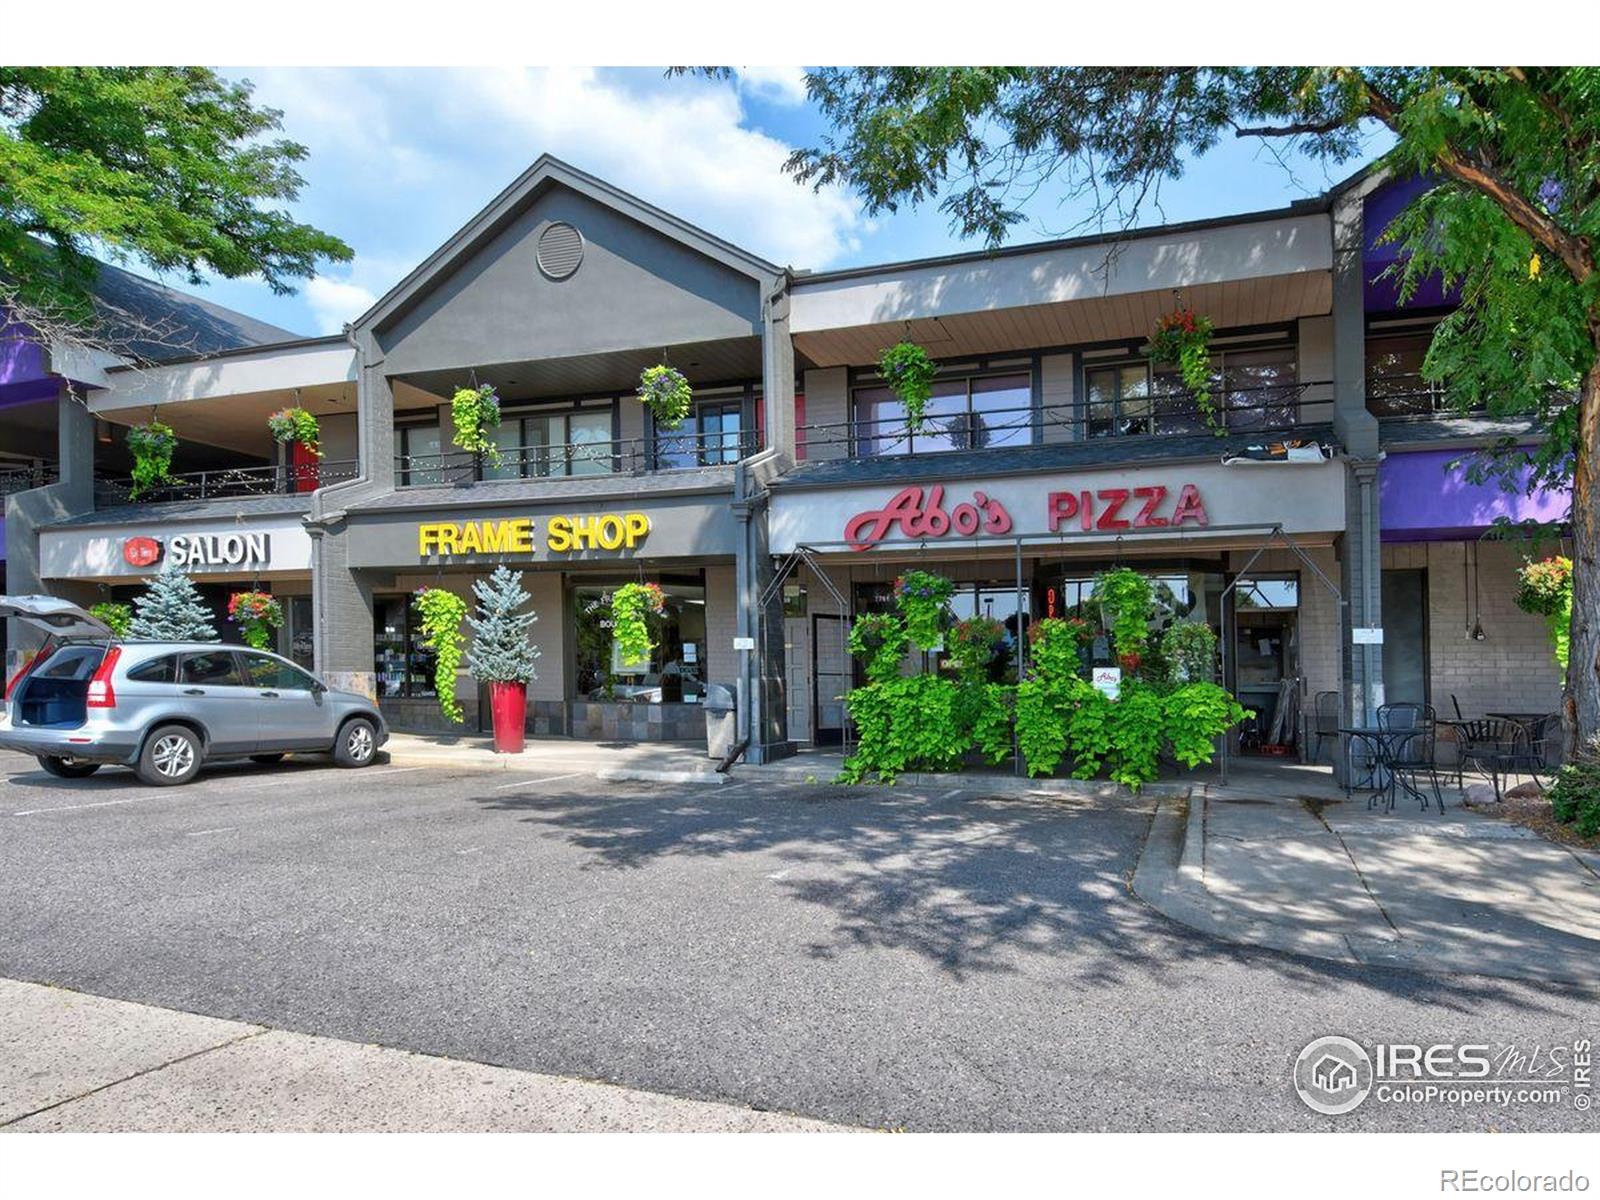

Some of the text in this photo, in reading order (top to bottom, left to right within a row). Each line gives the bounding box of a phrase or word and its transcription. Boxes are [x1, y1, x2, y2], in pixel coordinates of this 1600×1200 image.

[419, 511, 652, 556] FRAME SHOP
[844, 484, 1210, 551] Abo's PIZZA
[170, 533, 268, 565] SALON
[600, 619, 617, 629] BOU
